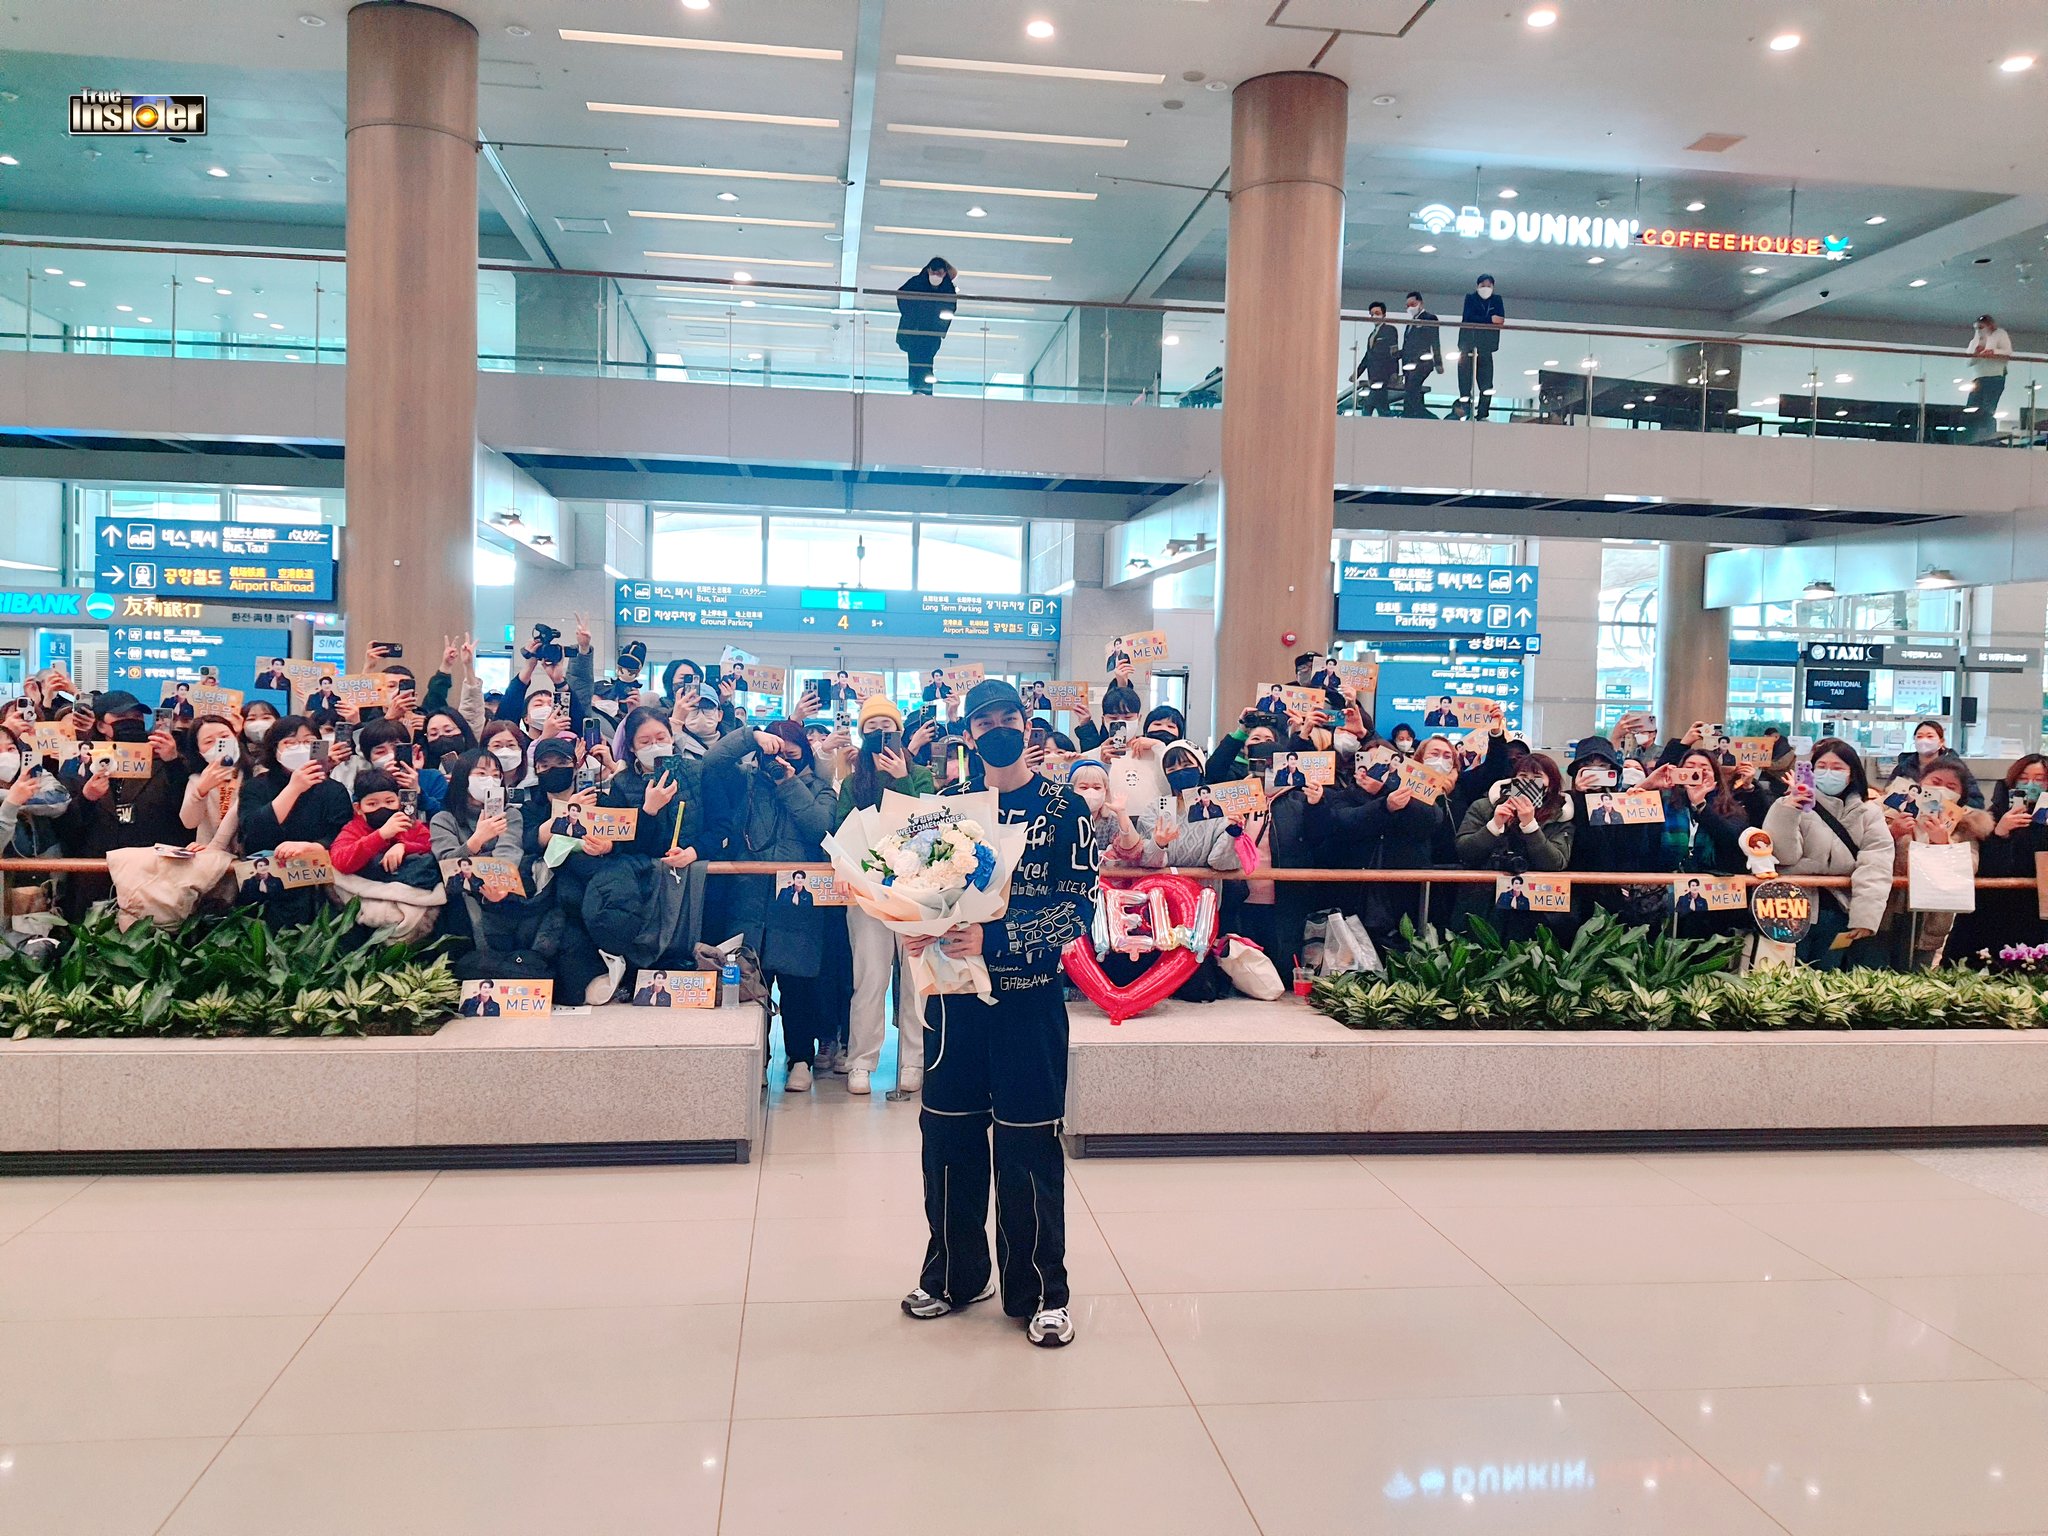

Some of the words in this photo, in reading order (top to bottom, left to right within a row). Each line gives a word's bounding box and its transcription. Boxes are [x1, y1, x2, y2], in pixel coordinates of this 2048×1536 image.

[1489, 209, 1639, 249] DUNKIN'
[229, 580, 269, 593] Airport
[270, 580, 315, 593] Railroad
[922, 603, 939, 613] Long
[940, 604, 957, 612] Term
[958, 605, 982, 614] Parking
[700, 618, 726, 626] Ground
[727, 619, 753, 628] Parking
[837, 614, 849, 630] 4
[1394, 615, 1437, 629] Parking
[943, 627, 964, 635] Airport
[964, 627, 989, 635] Railroad
[318, 639, 344, 648] SINC
[1133, 646, 1163, 659] MEW
[1826, 645, 1864, 660] TAXI
[751, 680, 780, 691] MEW
[1813, 680, 1862, 688] INTERNATIONAL
[1830, 688, 1845, 696] TAXI
[1291, 702, 1313, 712] ME
[1463, 713, 1492, 723] MEW
[37, 739, 59, 749] ME
[1741, 752, 1771, 762] MEW
[116, 761, 146, 772] EW
[1053, 773, 1070, 784] ME
[1405, 778, 1436, 798] MEW
[1627, 807, 1659, 818] MEW
[592, 825, 631, 836] MEW
[287, 867, 327, 881] MEW
[810, 875, 833, 889] 환영
[1534, 895, 1566, 906] MEW
[1712, 893, 1741, 905] MEW
[1755, 897, 1808, 919] MEW
[499, 986, 541, 997] WECOE
[506, 998, 546, 1011] MEW
